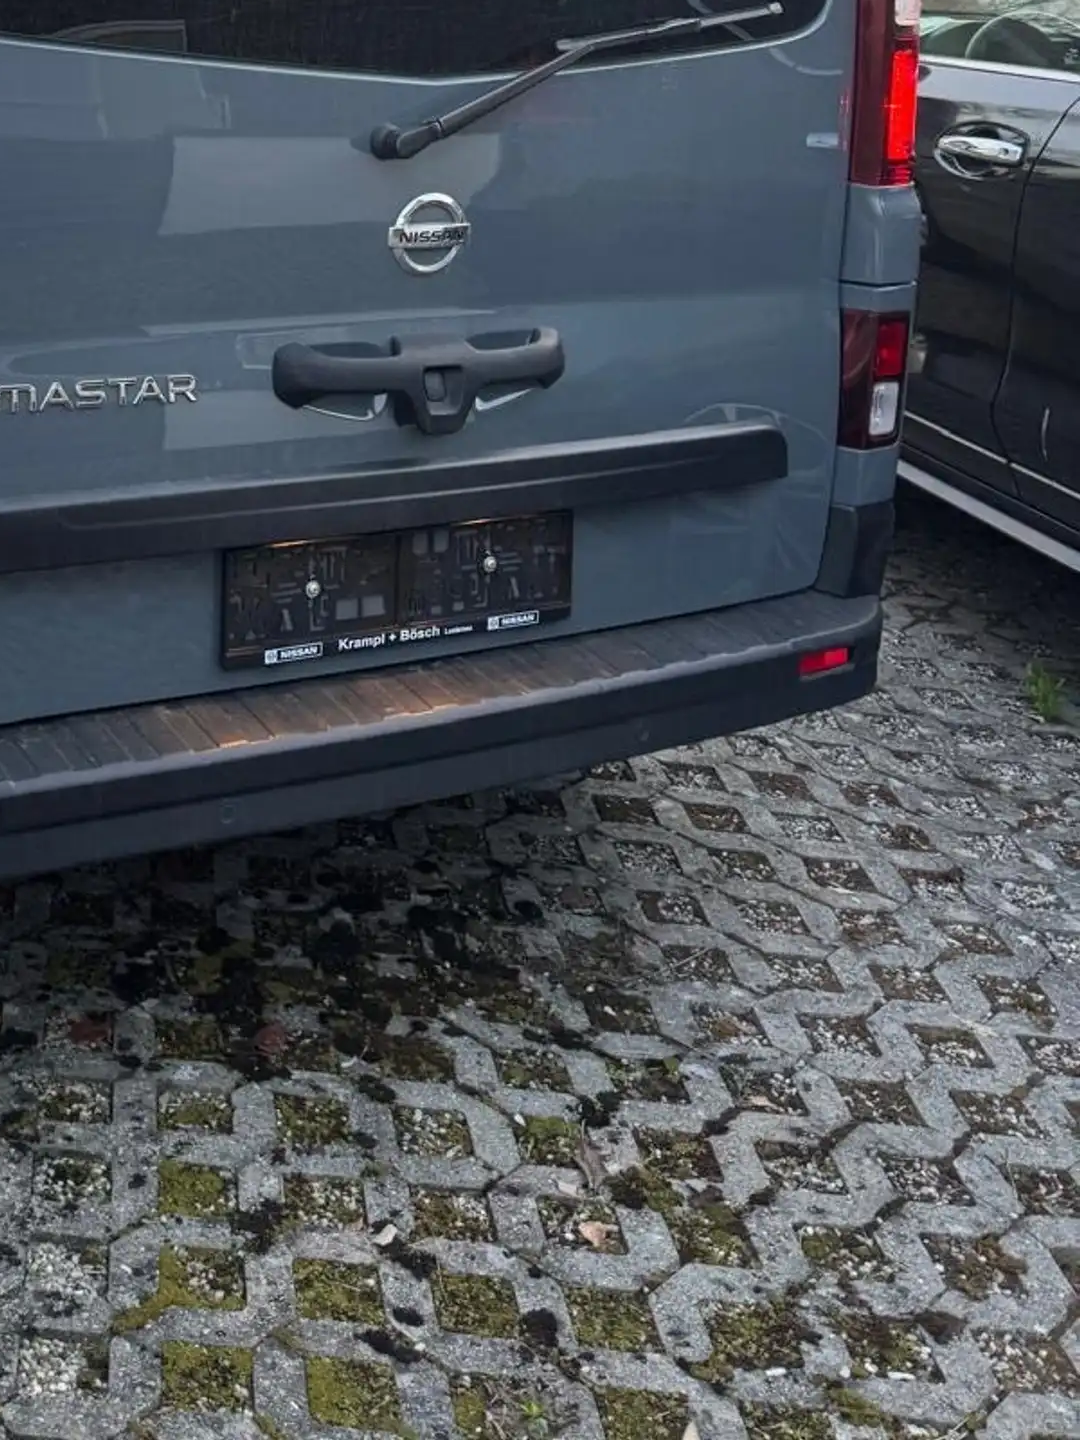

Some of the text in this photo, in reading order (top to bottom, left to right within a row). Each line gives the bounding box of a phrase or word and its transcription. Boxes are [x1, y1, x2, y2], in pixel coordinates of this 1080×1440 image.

[398, 229, 465, 244] NISSAN
[338, 633, 385, 651] Krampl
[388, 633, 397, 641] +
[400, 625, 441, 642] Bösch
[280, 645, 318, 659] NISSAN
